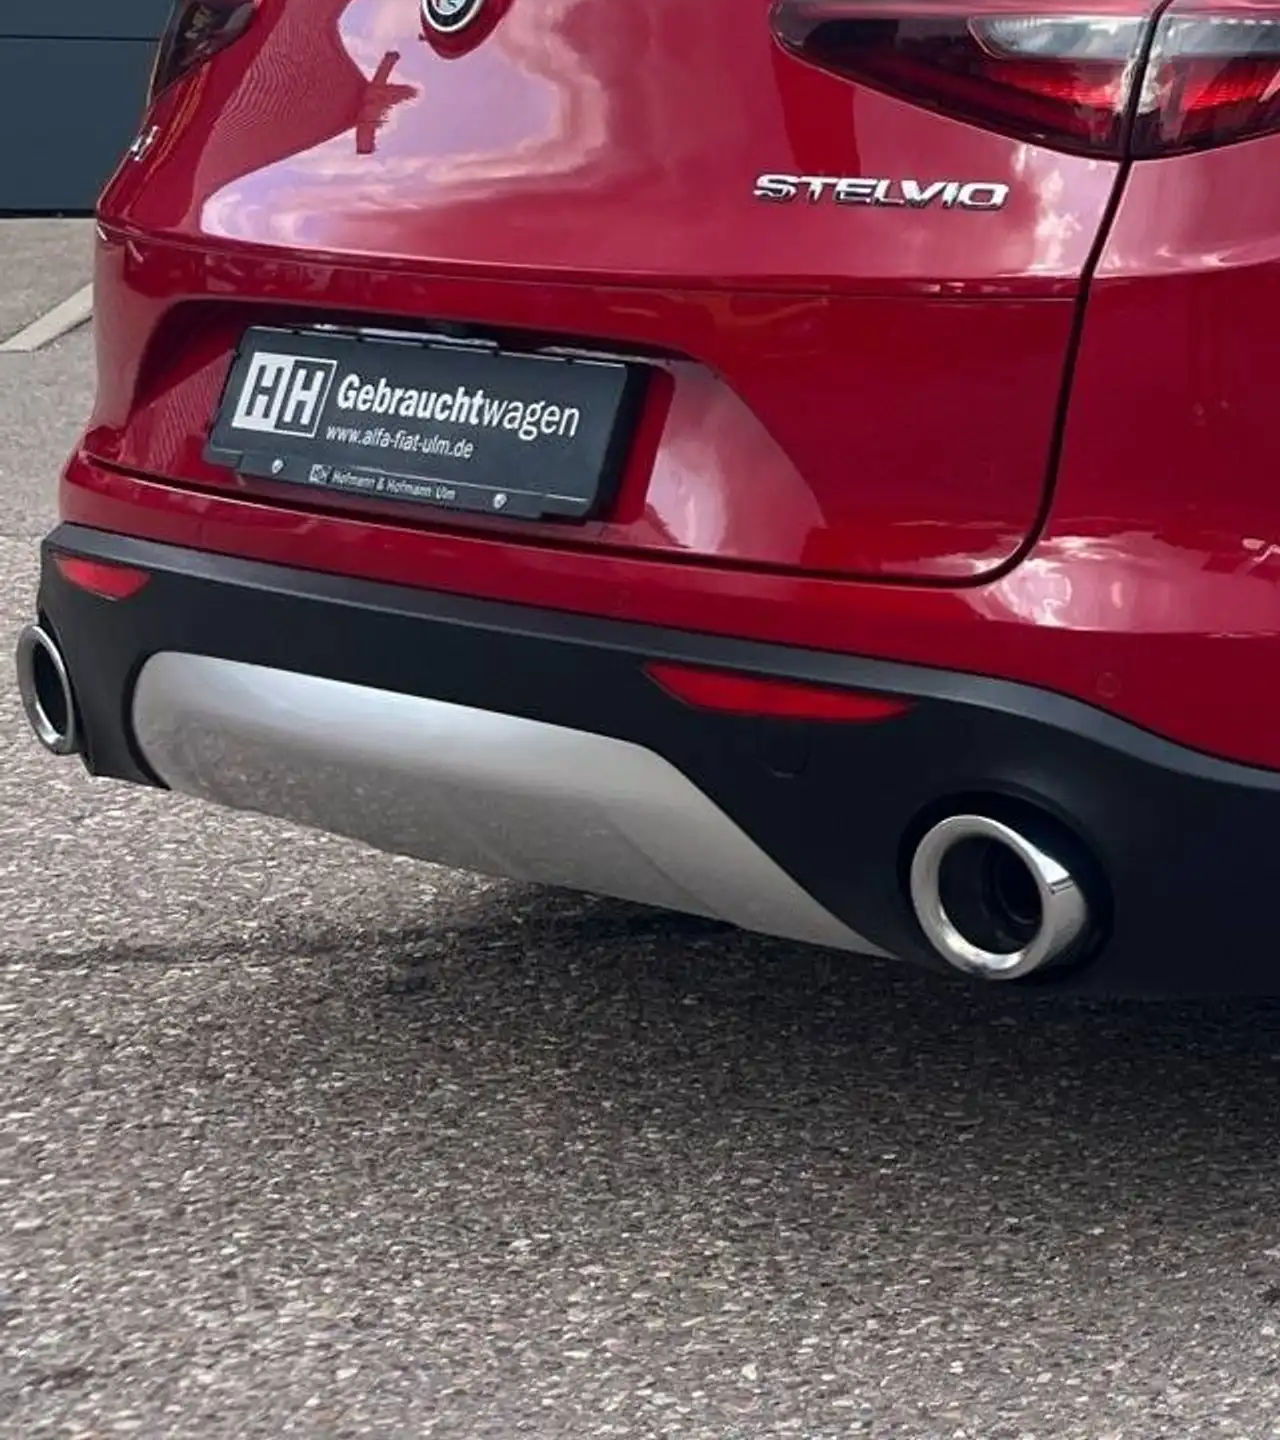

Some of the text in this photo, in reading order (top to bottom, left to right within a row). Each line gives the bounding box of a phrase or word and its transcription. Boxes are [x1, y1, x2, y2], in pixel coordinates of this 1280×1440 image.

[753, 173, 1010, 210] STELVIO
[336, 373, 580, 441] Gebrauchtwagen
[325, 423, 474, 460] www.alfa-fiat-ulm.de
[332, 471, 376, 488] Hofmann
[386, 479, 432, 498] Hofmann
